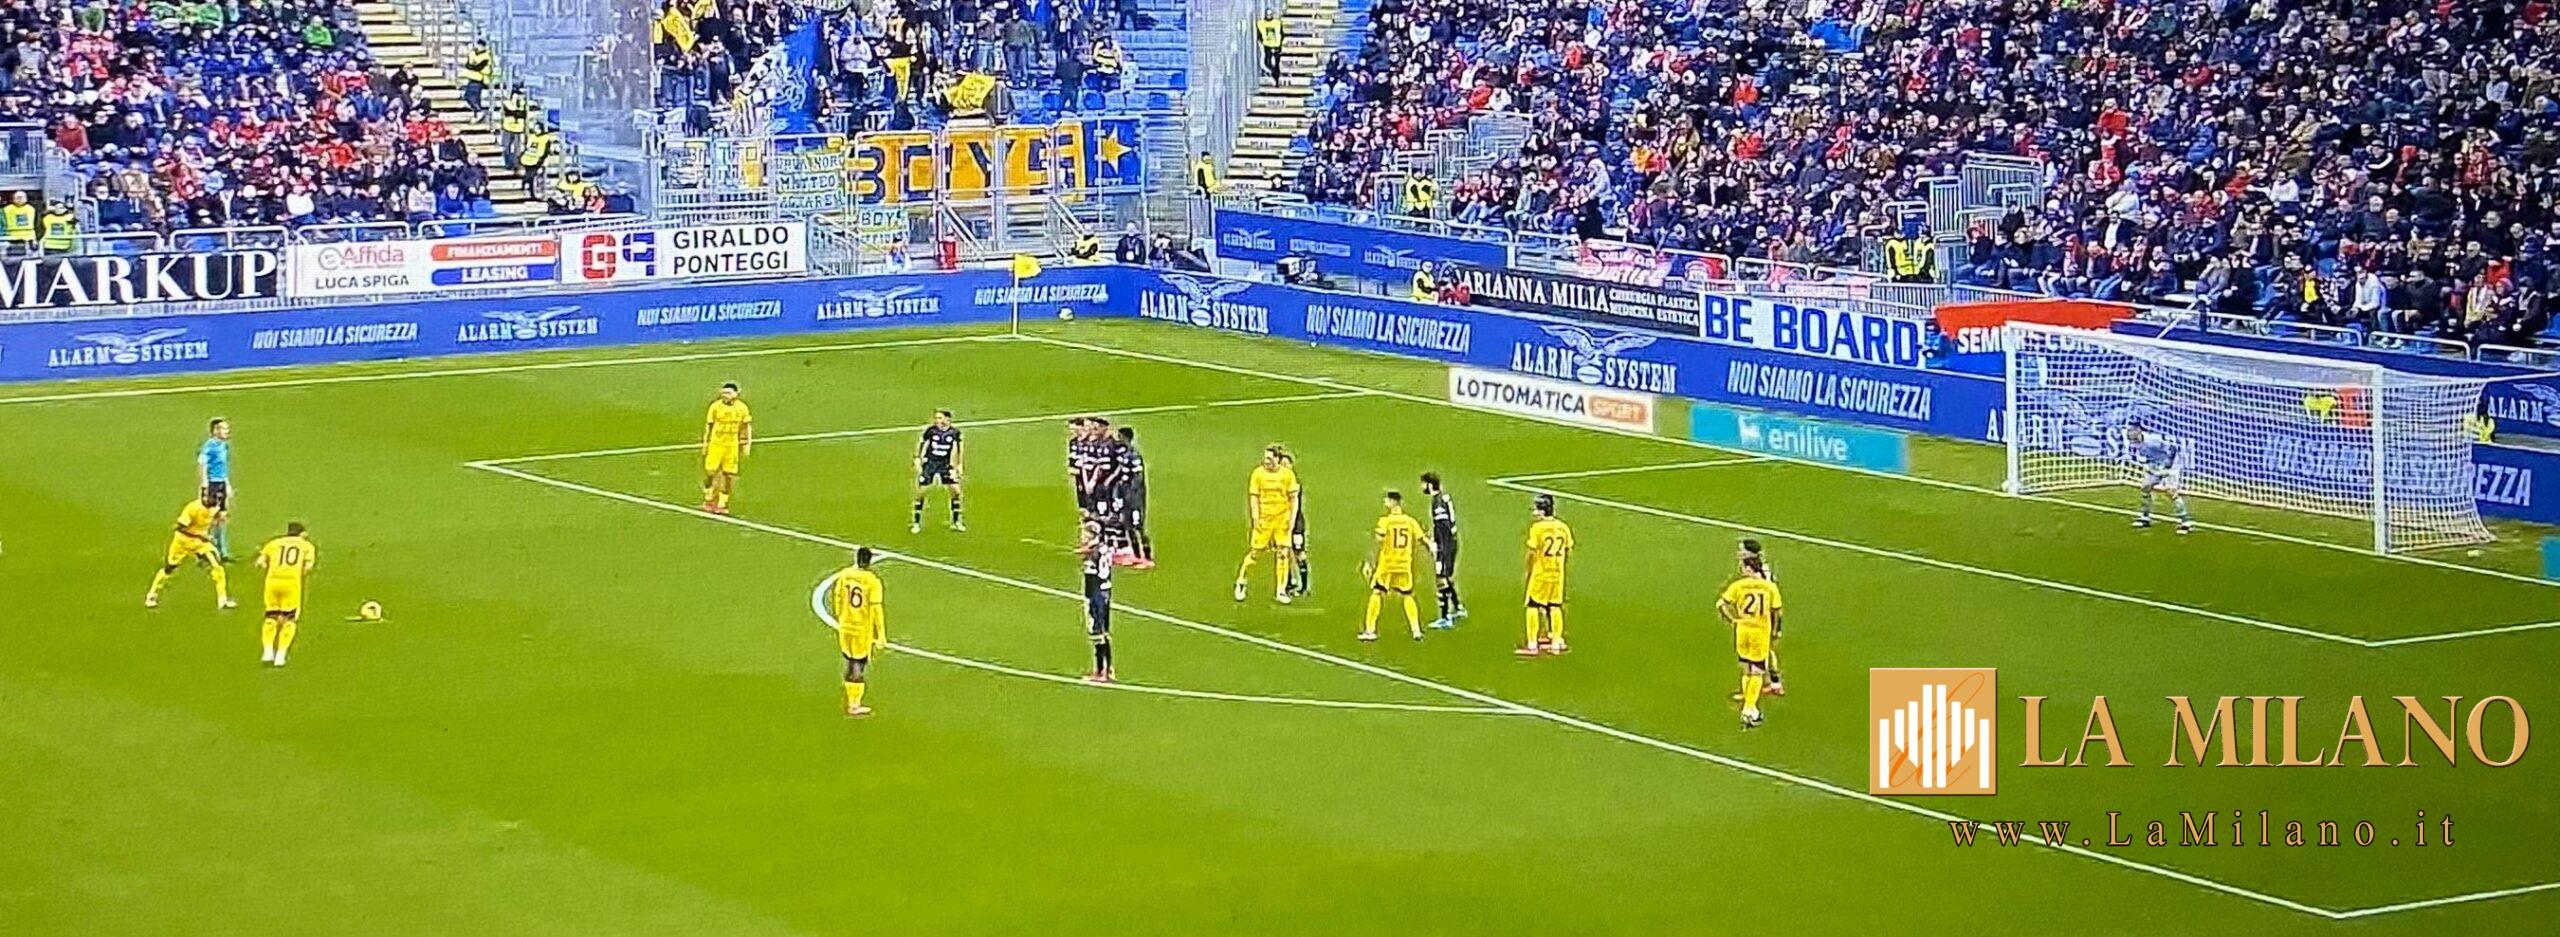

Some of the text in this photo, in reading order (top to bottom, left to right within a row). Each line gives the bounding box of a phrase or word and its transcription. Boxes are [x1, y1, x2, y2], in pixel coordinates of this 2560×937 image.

[673, 227, 788, 250] GIRALDO
[462, 266, 528, 282] LEASING
[673, 251, 788, 275] PONTEGGI
[0, 250, 278, 310] MARKUP
[315, 274, 409, 290] LUCA SPIGA
[1034, 285, 1050, 303] LA
[1551, 281, 1609, 313] MILIA
[660, 305, 701, 325] SIAMO
[700, 304, 717, 322] LA
[717, 300, 782, 321] SICUREZZA
[817, 297, 939, 320] ALARM SYSTEM
[1140, 289, 1269, 334] ALARM SYSTEM
[280, 327, 326, 348] SIAMO
[326, 325, 345, 345] LA
[345, 322, 418, 344] SICUREZZA
[457, 317, 598, 342] ALARM SYSTEM
[1306, 304, 1472, 356] NOI SIAMO LA SICUREZZA
[1704, 294, 1919, 368] BE BOARD
[48, 341, 209, 367] ALARM SYSTEM
[1512, 341, 1678, 394] ALARM SYSTEM
[1456, 376, 1643, 422] LOTTOMATICA SPORT
[1727, 360, 1932, 421] NOI SIAMO LA SICUREZZA
[2487, 395, 2544, 424] ALARM
[1768, 420, 1849, 461] enilive
[1392, 527, 1409, 549] 15
[1544, 536, 1566, 557] 22
[278, 545, 300, 566] 10
[845, 585, 863, 608] 16
[1743, 593, 1764, 616] 21
